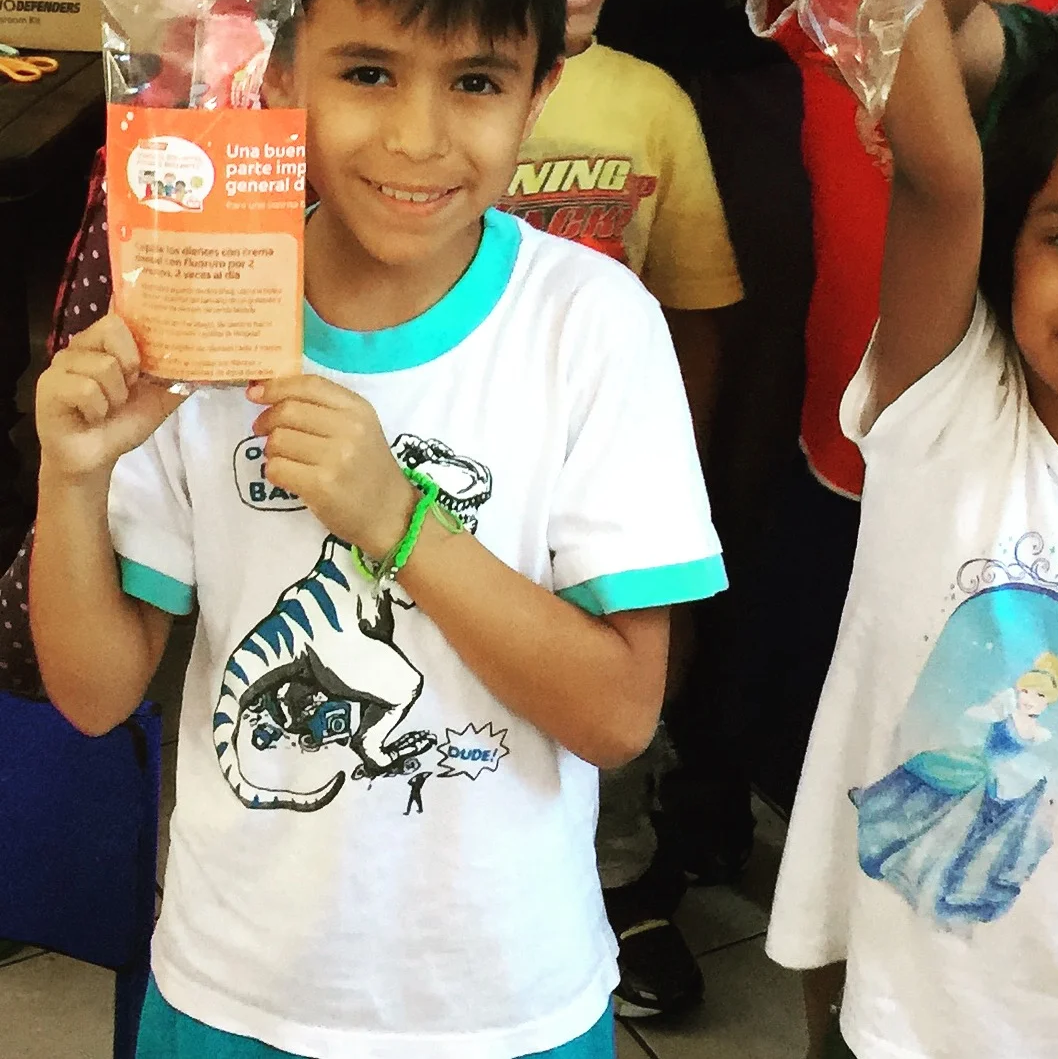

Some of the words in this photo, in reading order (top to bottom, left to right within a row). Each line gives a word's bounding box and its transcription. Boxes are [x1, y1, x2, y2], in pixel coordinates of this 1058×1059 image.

[226, 143, 260, 159] Una
[264, 143, 306, 158] buen
[226, 161, 273, 179] parte
[276, 159, 307, 178] imp
[225, 177, 290, 197] general
[249, 481, 299, 502] BA
[448, 745, 498, 762] DUDE!
